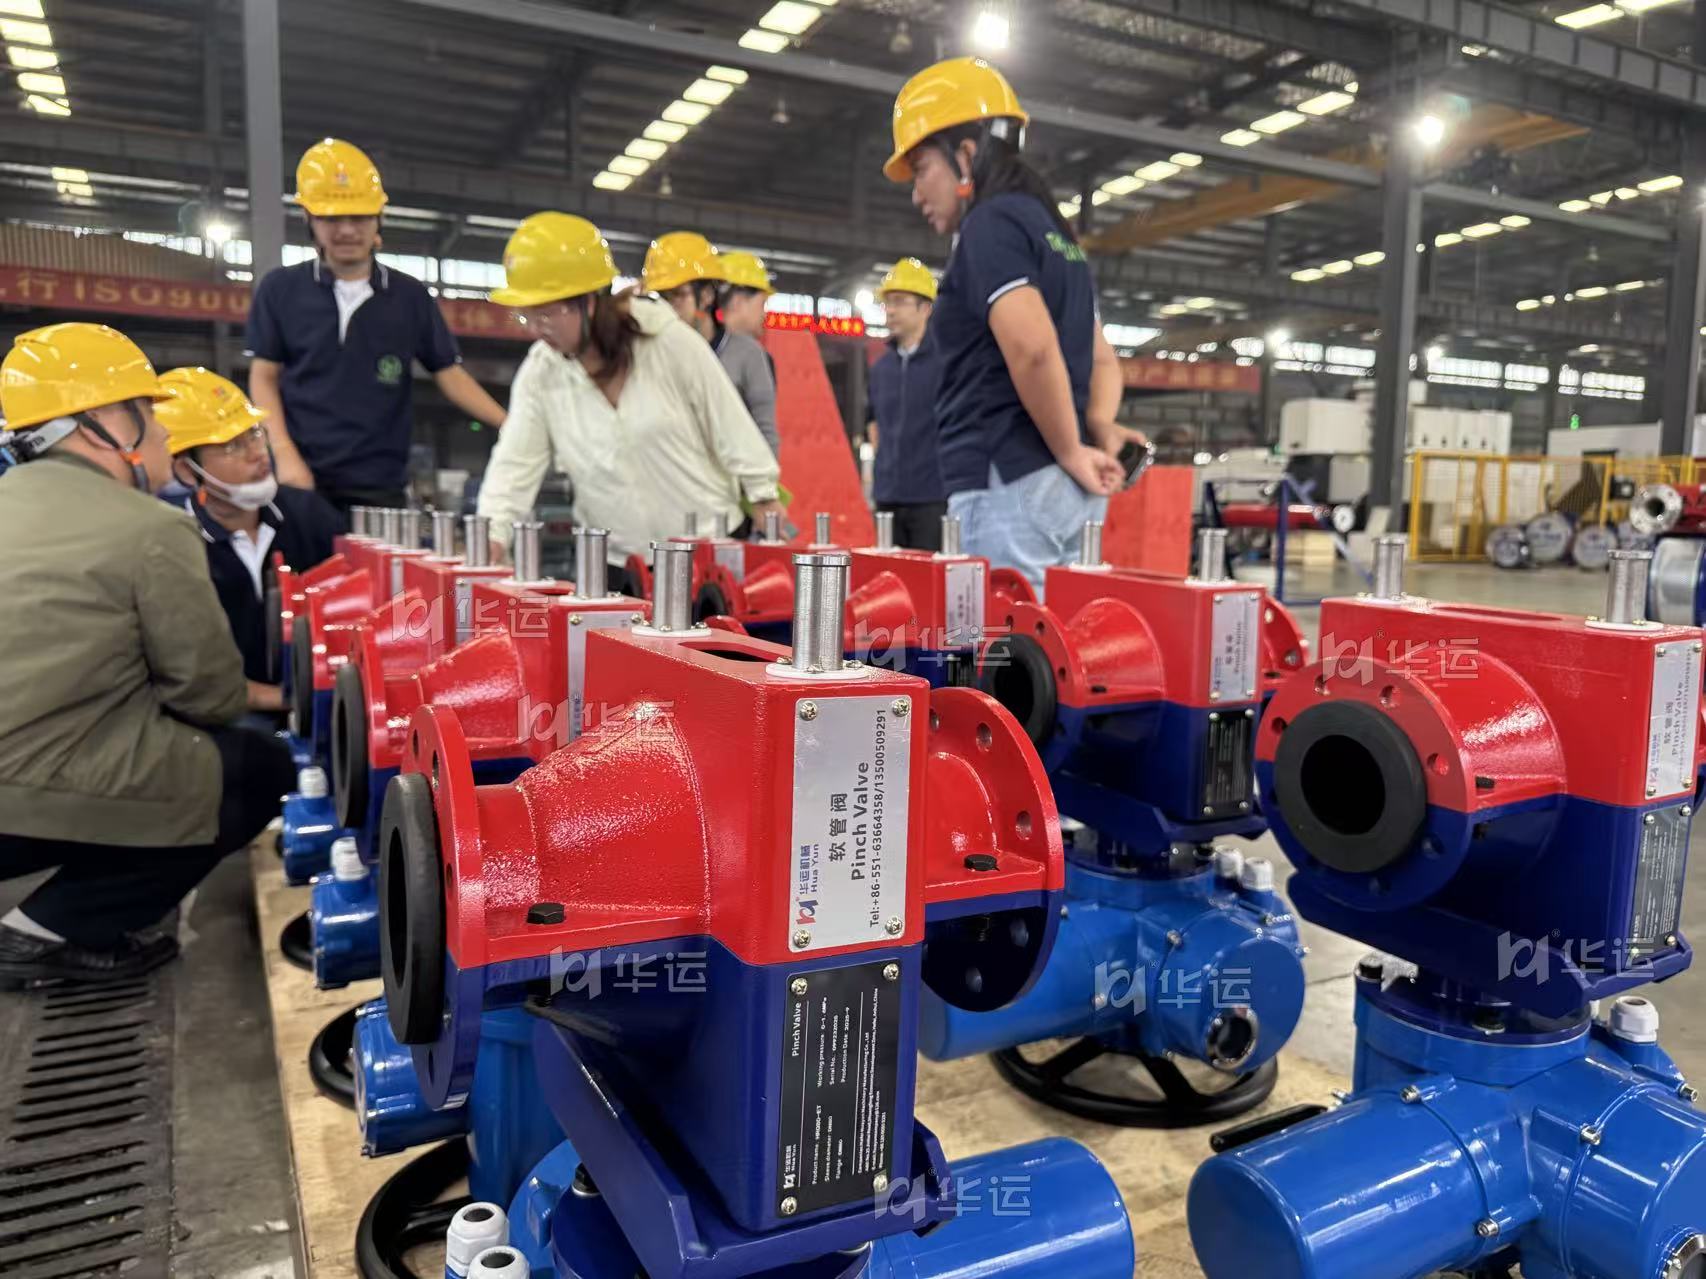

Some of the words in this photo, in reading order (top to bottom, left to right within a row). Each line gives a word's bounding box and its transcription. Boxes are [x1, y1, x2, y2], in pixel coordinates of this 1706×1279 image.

[0, 271, 252, 312] 行ISO900
[853, 762, 869, 818] Valve
[829, 793, 847, 862] 软管阀
[870, 709, 886, 928] Tel:+86-551-63664358/13500509291
[800, 845, 811, 894] 华运机械
[811, 844, 819, 866] Yun
[851, 823, 867, 880] Pinch
[811, 869, 819, 893] Hua
[793, 1002, 802, 1029] Valve
[792, 1030, 801, 1057] Pinch
[840, 1049, 848, 1083] Production
